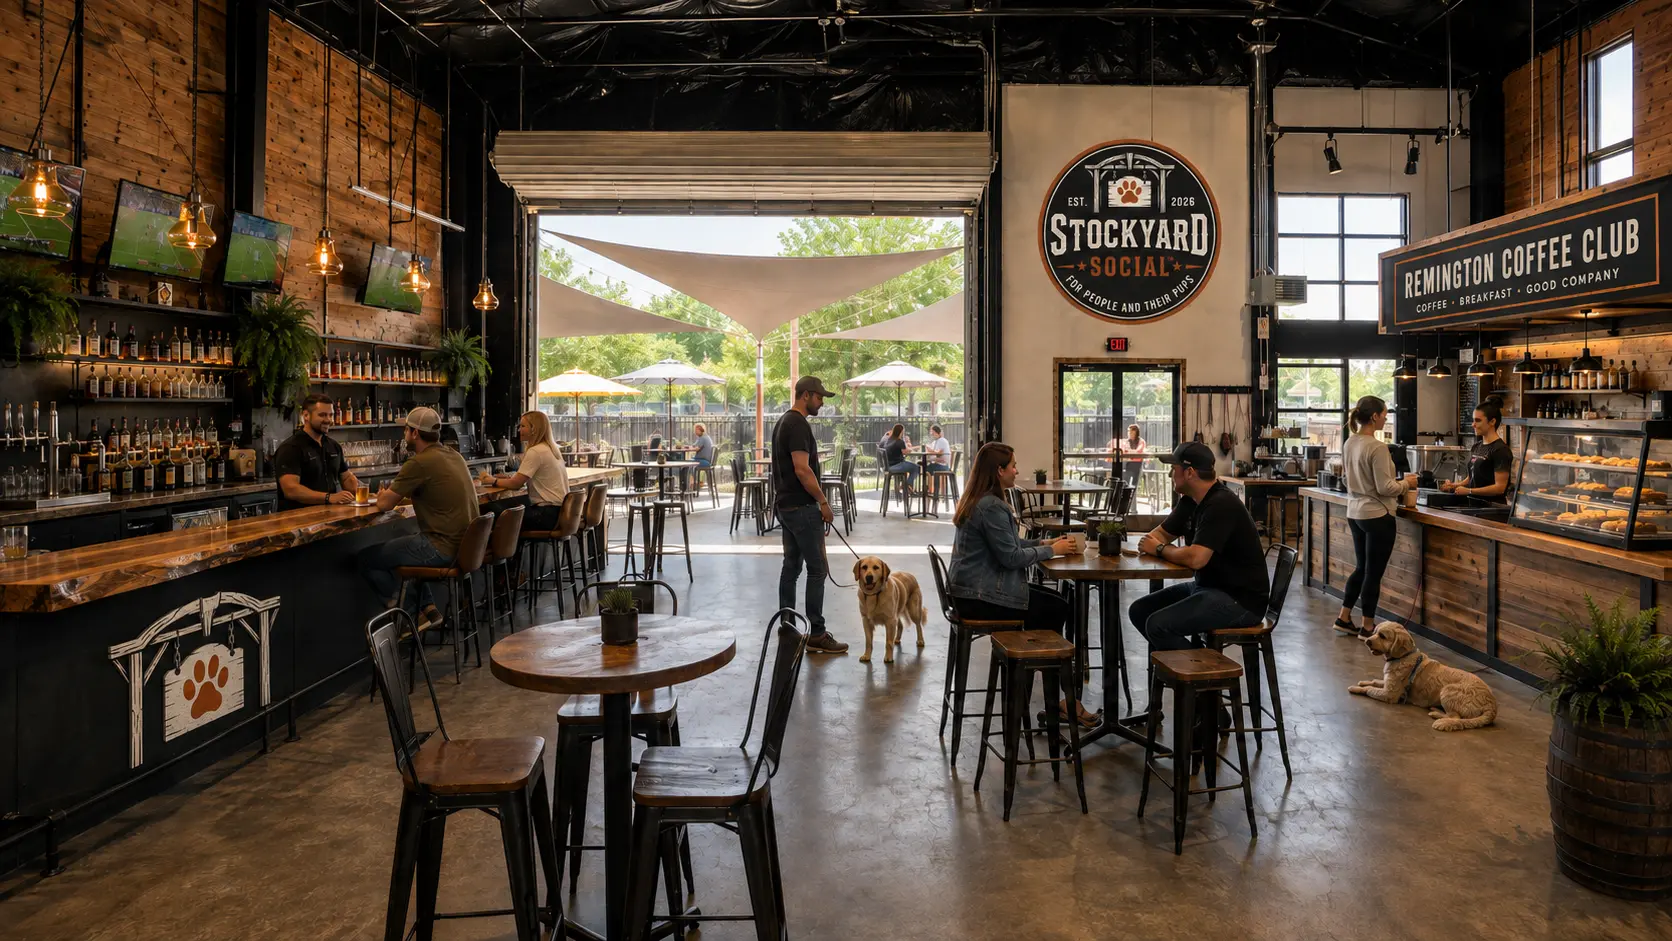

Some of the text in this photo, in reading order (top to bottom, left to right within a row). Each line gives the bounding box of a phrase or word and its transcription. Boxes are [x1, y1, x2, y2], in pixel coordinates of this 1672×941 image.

[1068, 197, 1195, 207] EST. 2026
[1050, 213, 1208, 257] STOCKYARD
[1090, 256, 1169, 277] SOCIAL
[1405, 218, 1639, 299] REMINGTON COFFEE CLUB
[1065, 275, 1195, 313] FOR PEOPLE AND THEIR PUPS
[1416, 268, 1620, 313] COFFEE BREAKFAST GOOD COMPANY
